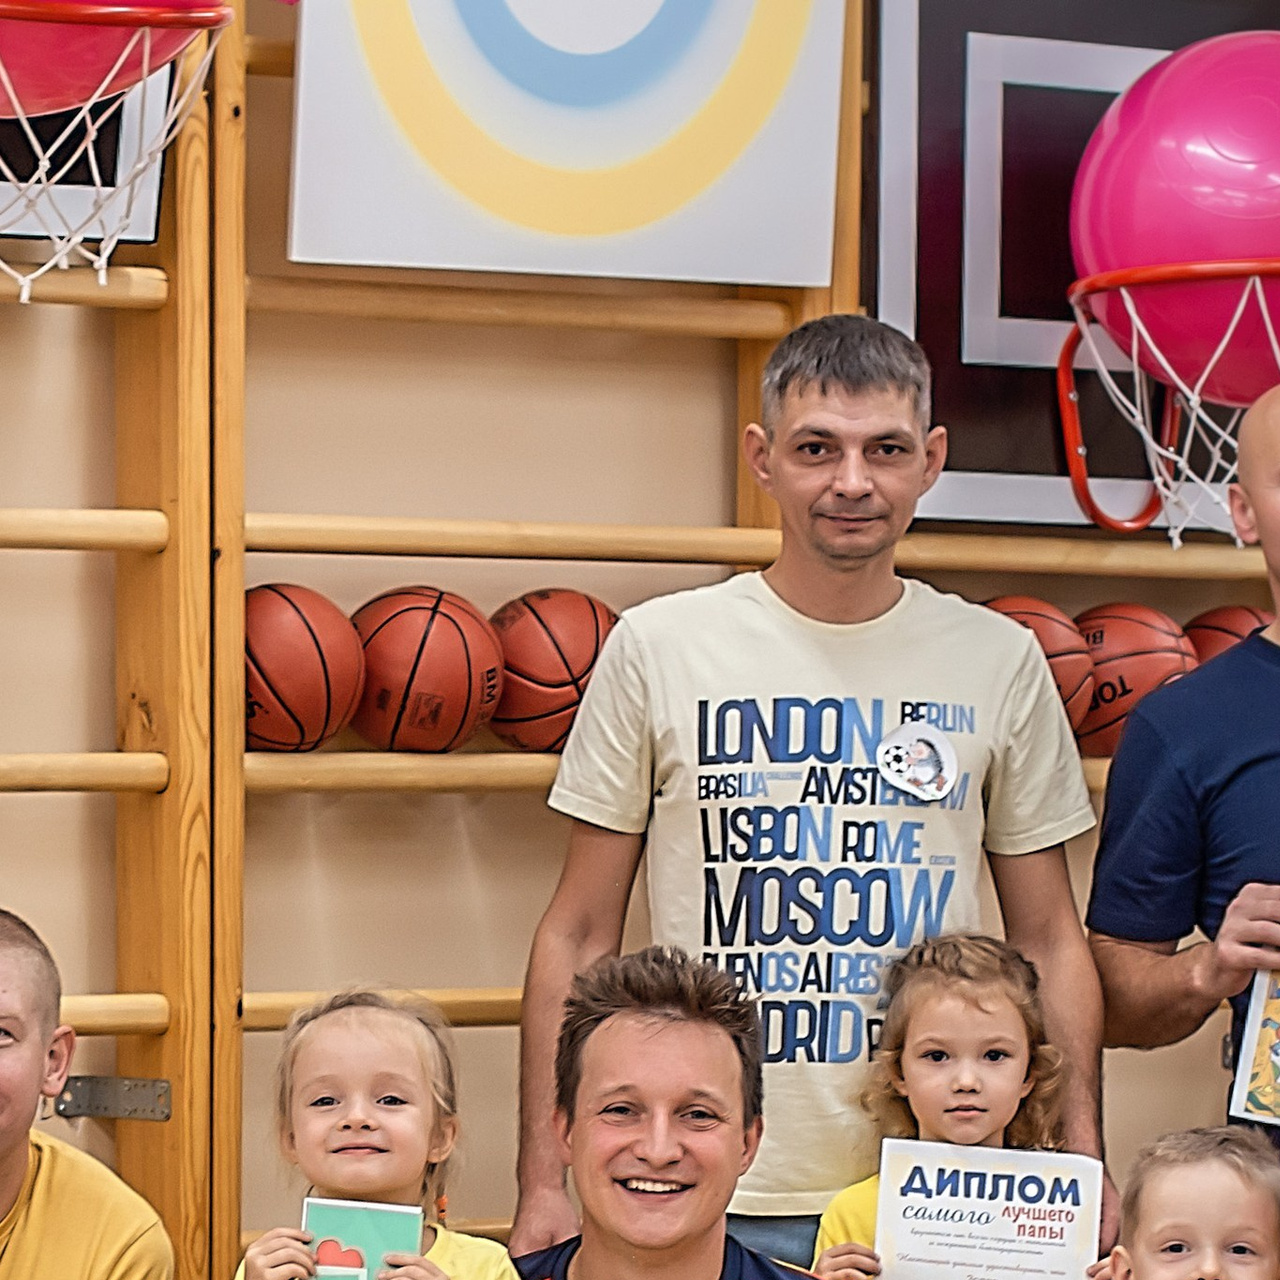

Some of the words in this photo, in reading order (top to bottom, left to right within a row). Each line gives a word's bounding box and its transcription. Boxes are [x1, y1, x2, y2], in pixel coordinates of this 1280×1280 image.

[698, 697, 884, 766] LONDON
[901, 701, 976, 735] BERLIN
[697, 771, 769, 801] BRASILIA
[699, 805, 833, 863] LISBON
[841, 820, 925, 865] ROME
[703, 866, 957, 949] MOSCOW
[760, 1000, 864, 1064] DRID
[900, 1166, 1081, 1206] ДИПЛОМ
[902, 1204, 997, 1225] самого
[1001, 1206, 1076, 1223] лучшего
[1016, 1224, 1065, 1240] папы
